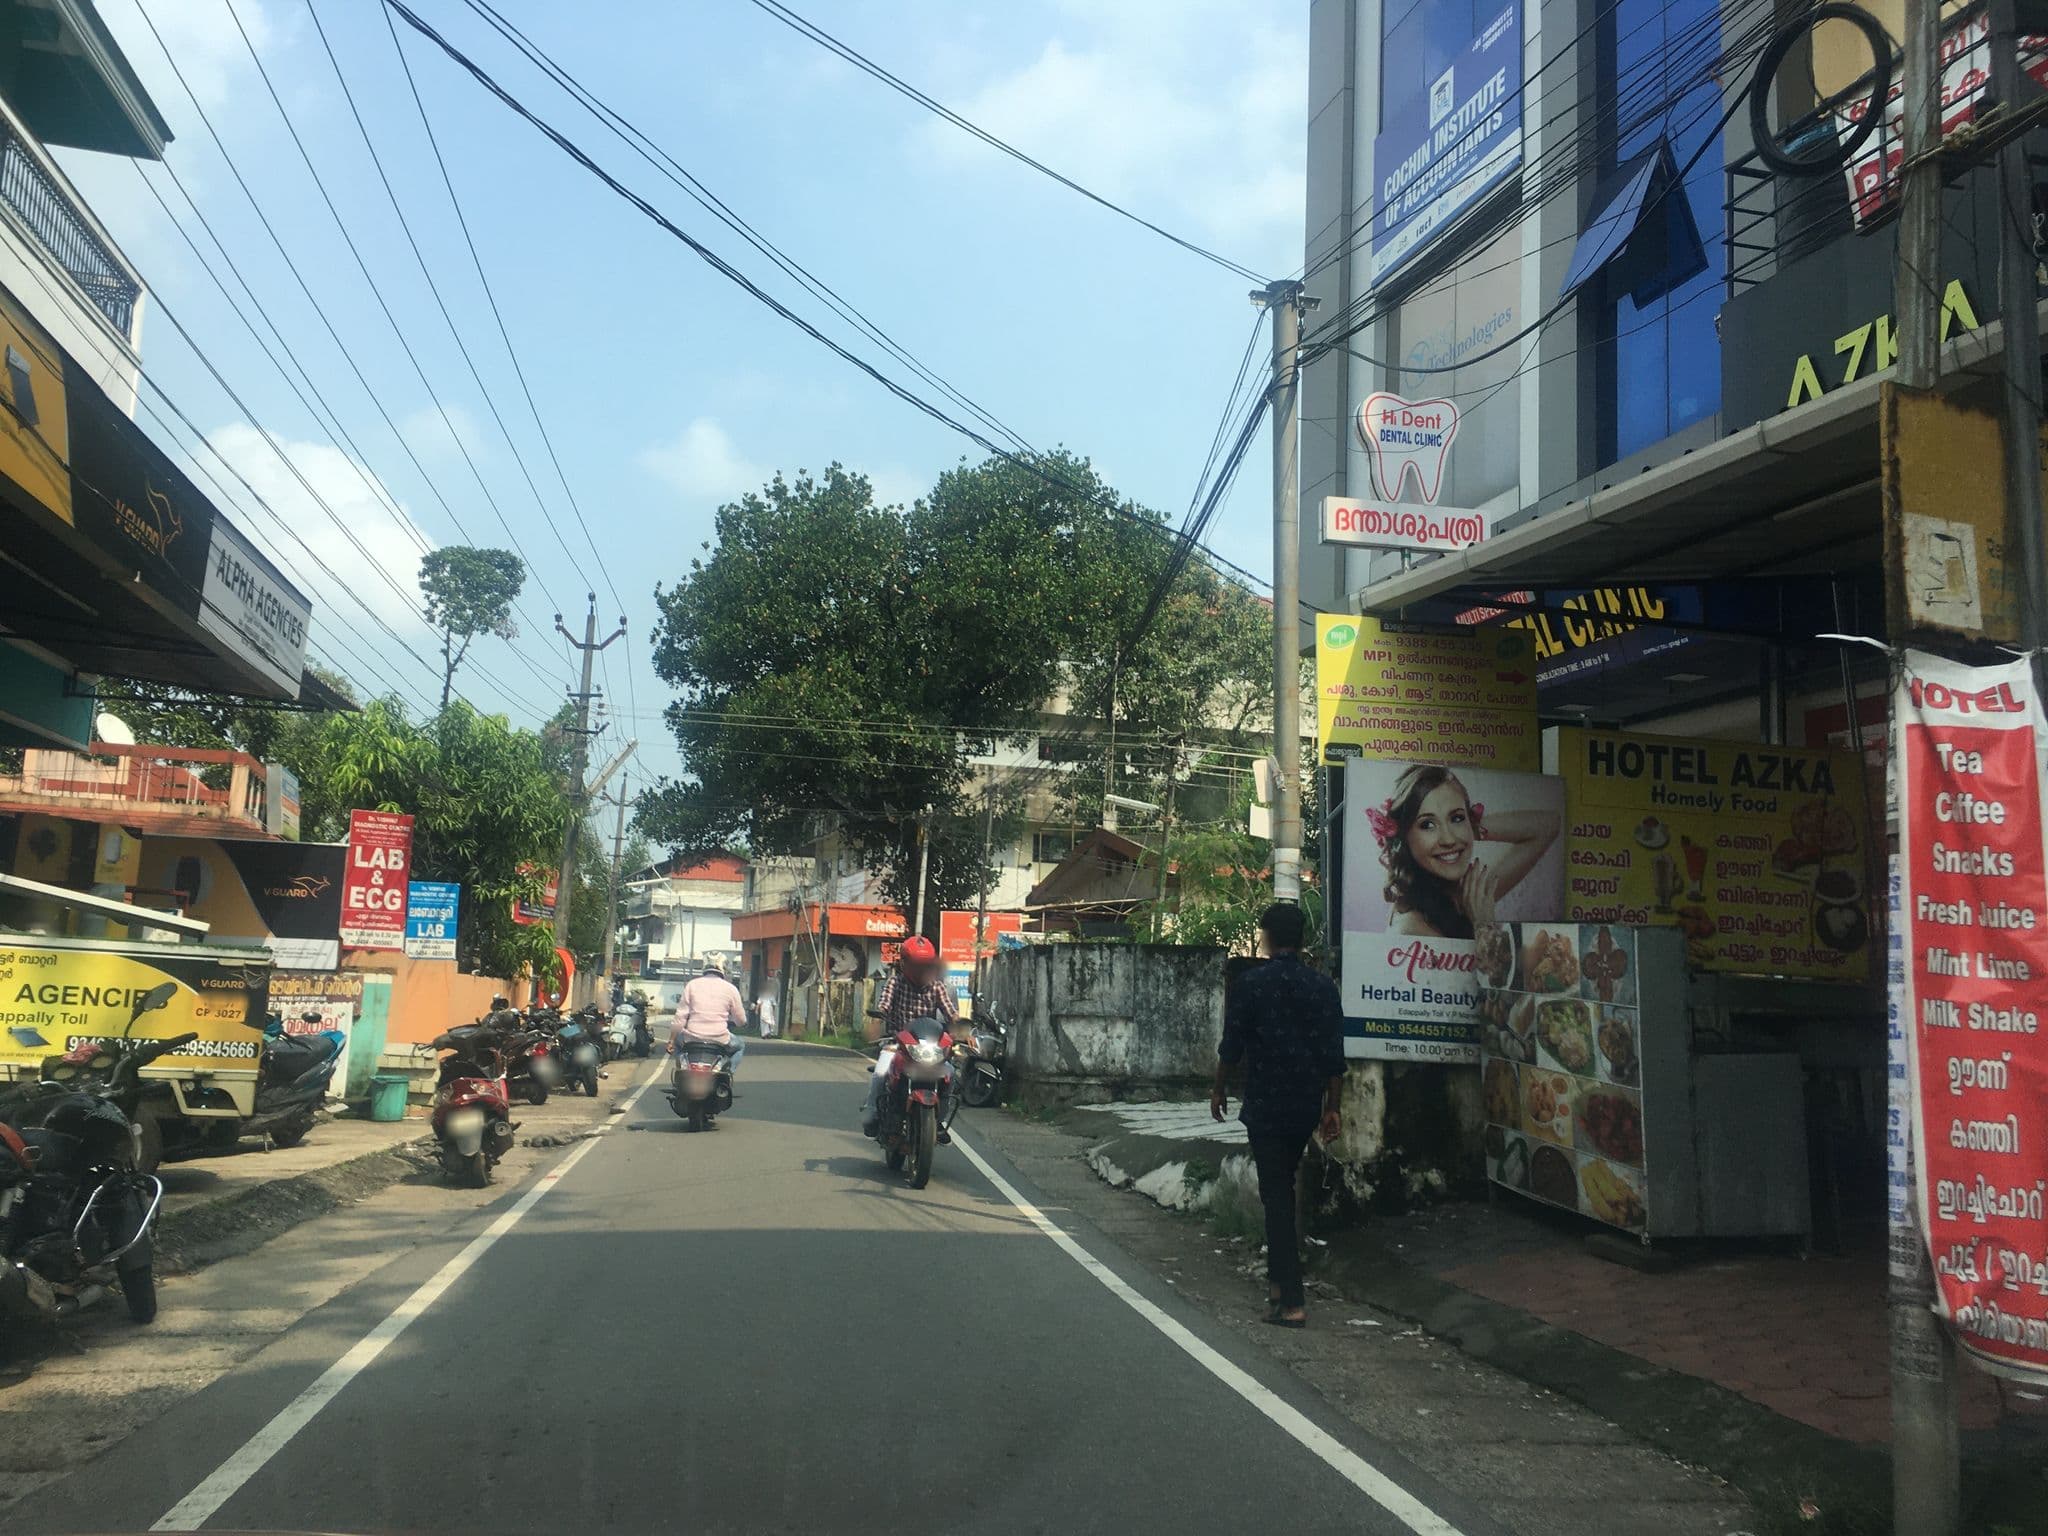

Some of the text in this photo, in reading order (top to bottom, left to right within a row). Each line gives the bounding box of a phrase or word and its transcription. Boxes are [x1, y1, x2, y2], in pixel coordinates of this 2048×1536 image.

[1384, 138, 1431, 202] COCHIN
[1434, 66, 1506, 155] INSTITUTE
[1385, 196, 1401, 228] OF
[1403, 103, 1503, 210] ACCOUNTANTS
[1381, 409, 1441, 429] Hi Dent
[1380, 429, 1442, 447] DENTAL CLINIC
[216, 548, 255, 607] ALPHA
[256, 585, 304, 650] AGENCIES
[1563, 587, 1665, 648] CLINIC
[1364, 650, 1392, 662] MPI
[1381, 668, 1434, 682] വിപണന
[1333, 717, 1433, 733] വാഹനങ്ങളുടെ
[1364, 738, 1423, 754] പുതുക്കി
[1428, 741, 1496, 759] നൽകുന്നു
[1937, 743, 1983, 774] Tea
[1588, 740, 1718, 785] HOTEL
[1730, 752, 1836, 796] AZKA
[1651, 784, 1777, 813] Homely Food
[1571, 822, 1612, 839] ചായ
[354, 846, 404, 870] LAB
[1570, 850, 1631, 868] കോഫി
[1716, 860, 1765, 880] ഊണ്
[1932, 842, 2015, 877] Snacks
[371, 870, 384, 885] &
[349, 886, 402, 911] ECG
[1716, 888, 1809, 909] ബിരിയാണി
[1916, 895, 1973, 927] Fresh
[417, 923, 444, 937] LAB
[1927, 947, 2031, 981] Mint Lime
[1361, 984, 1479, 1010] Herbal Beauty
[60, 1012, 88, 1025] Toll
[1365, 1021, 1394, 1034] Mob:
[1922, 998, 2038, 1034] Milk Shake
[1385, 1043, 1409, 1054] Time:
[1948, 1051, 2012, 1096] ഊണ്
[1950, 1113, 2020, 1154] കഞ്ഞി
